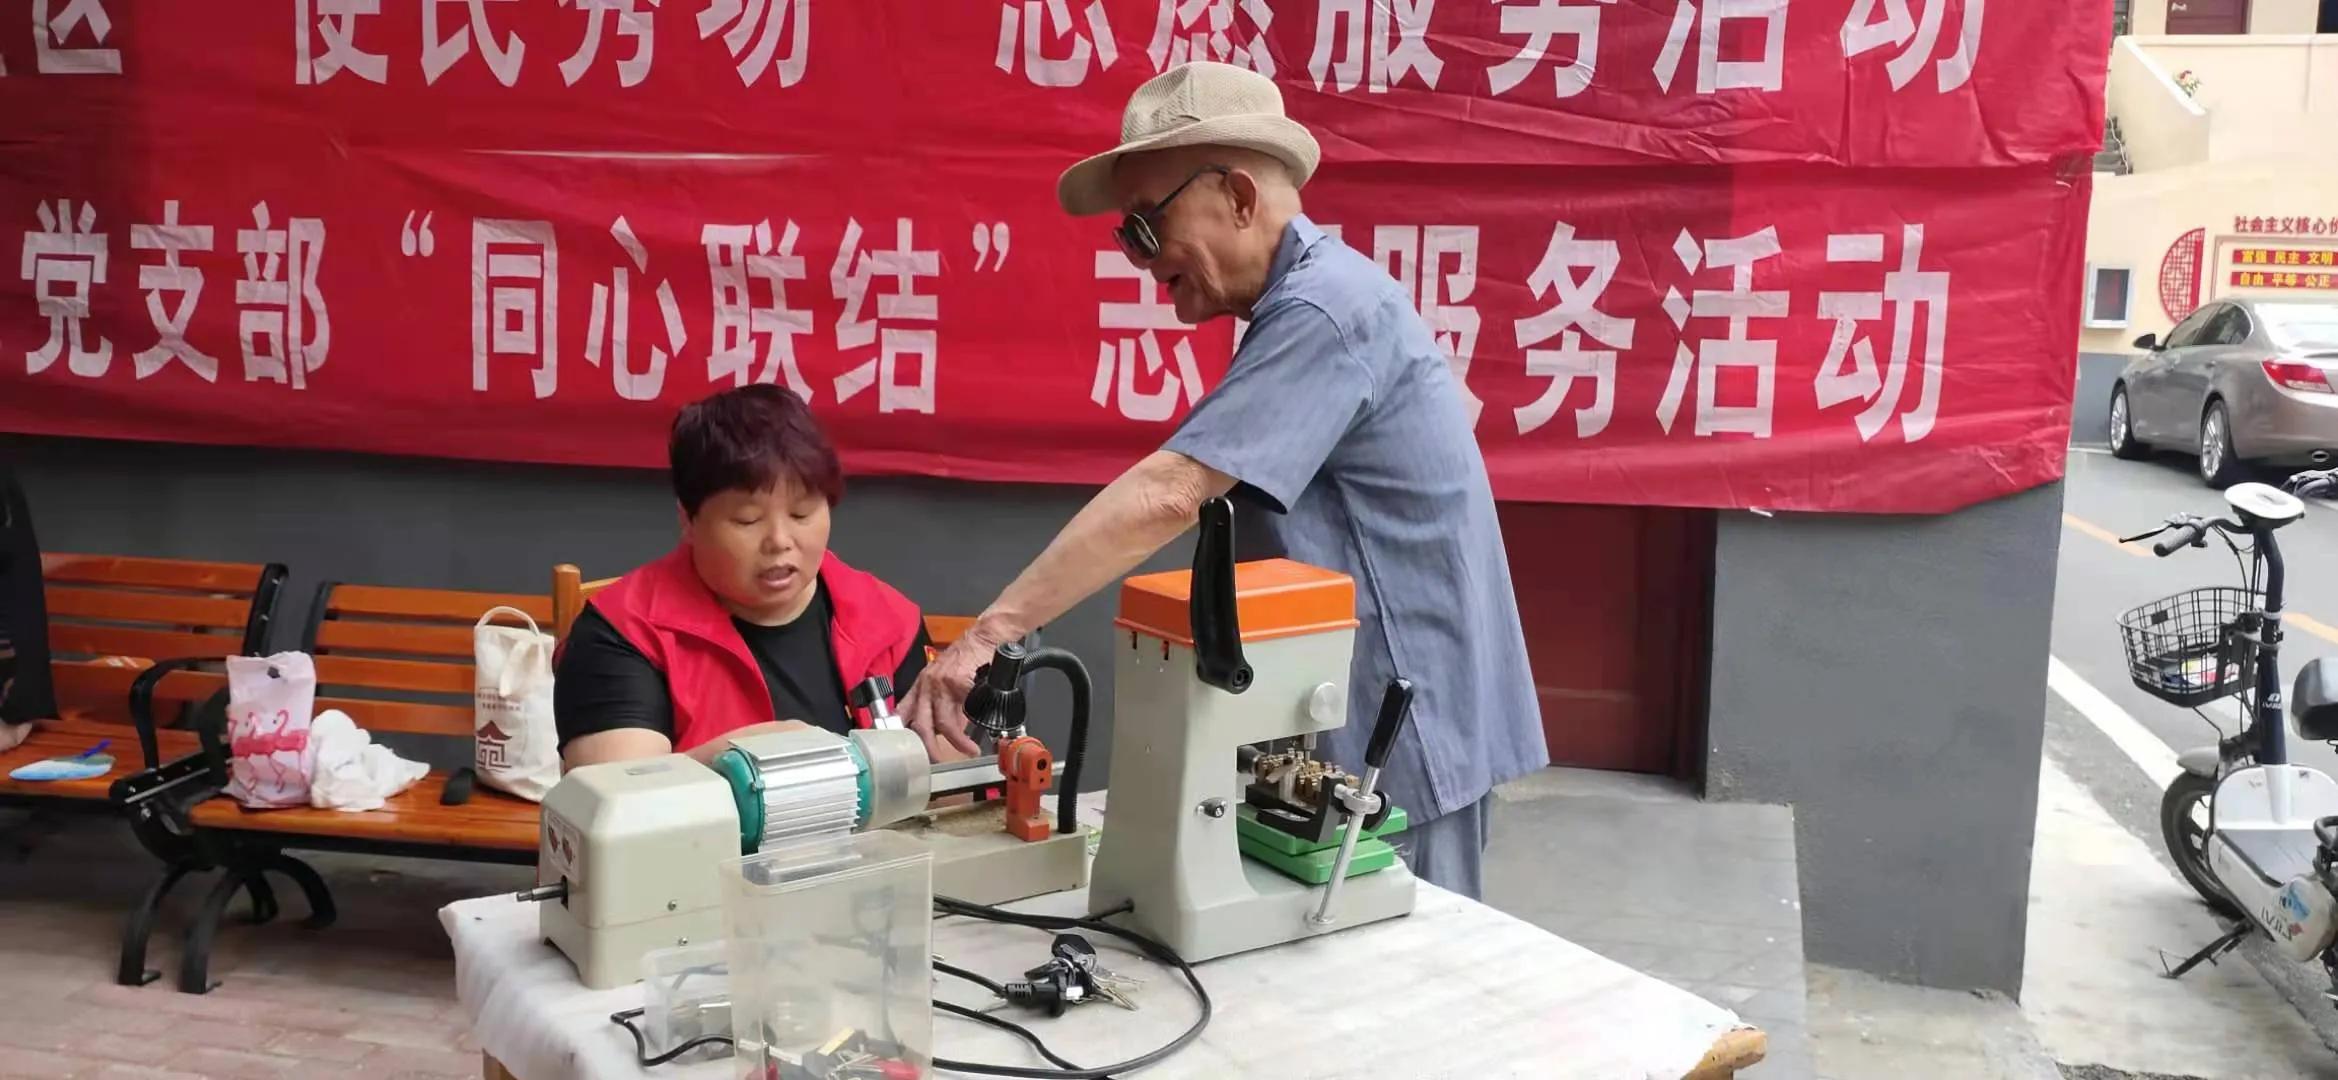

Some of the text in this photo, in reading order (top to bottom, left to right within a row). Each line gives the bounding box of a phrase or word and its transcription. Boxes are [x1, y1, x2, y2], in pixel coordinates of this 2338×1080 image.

[2307, 251, 2334, 265] 文明
[2240, 271, 2264, 287] 自由
[21, 198, 1950, 443] 党支部“同心联结”志服务活动
